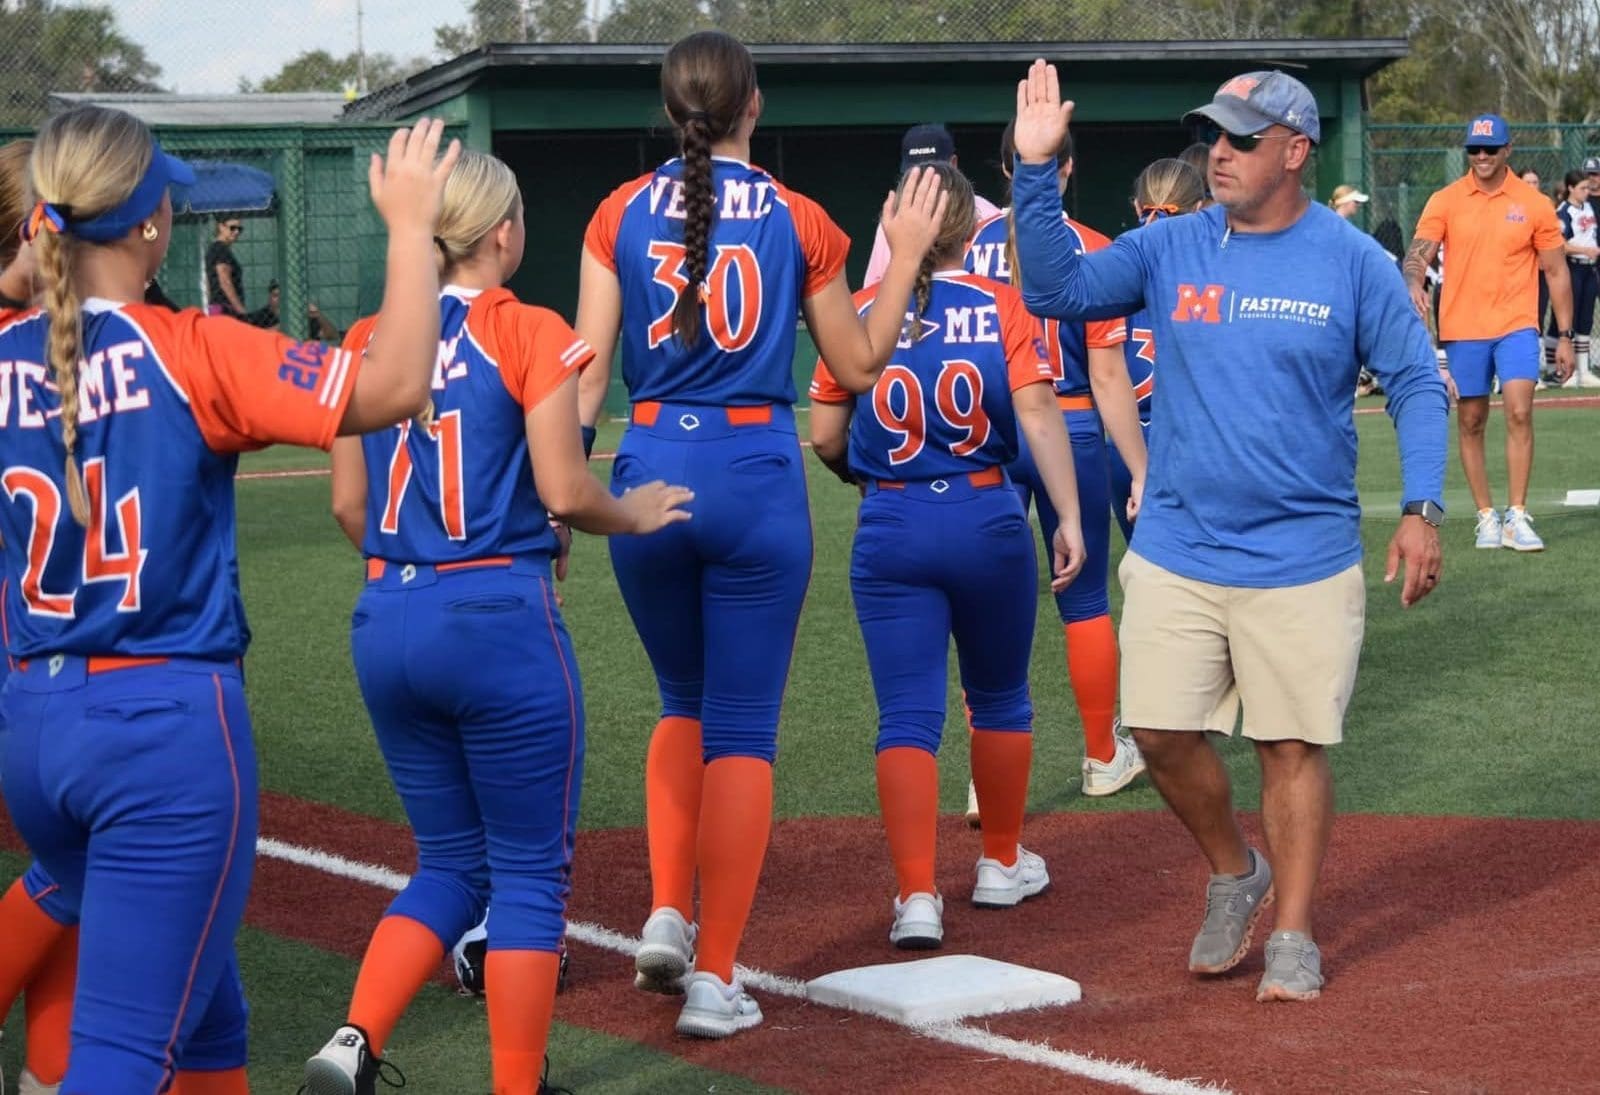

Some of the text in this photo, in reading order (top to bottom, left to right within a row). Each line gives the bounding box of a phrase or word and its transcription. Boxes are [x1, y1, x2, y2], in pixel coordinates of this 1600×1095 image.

[1471, 119, 1494, 137] M
[647, 240, 763, 353] 30
[1171, 283, 1226, 324] M
[1239, 297, 1331, 320] FASTPITCH
[943, 304, 1000, 344] ME
[872, 358, 991, 466] 99
[1, 455, 149, 620] 24
